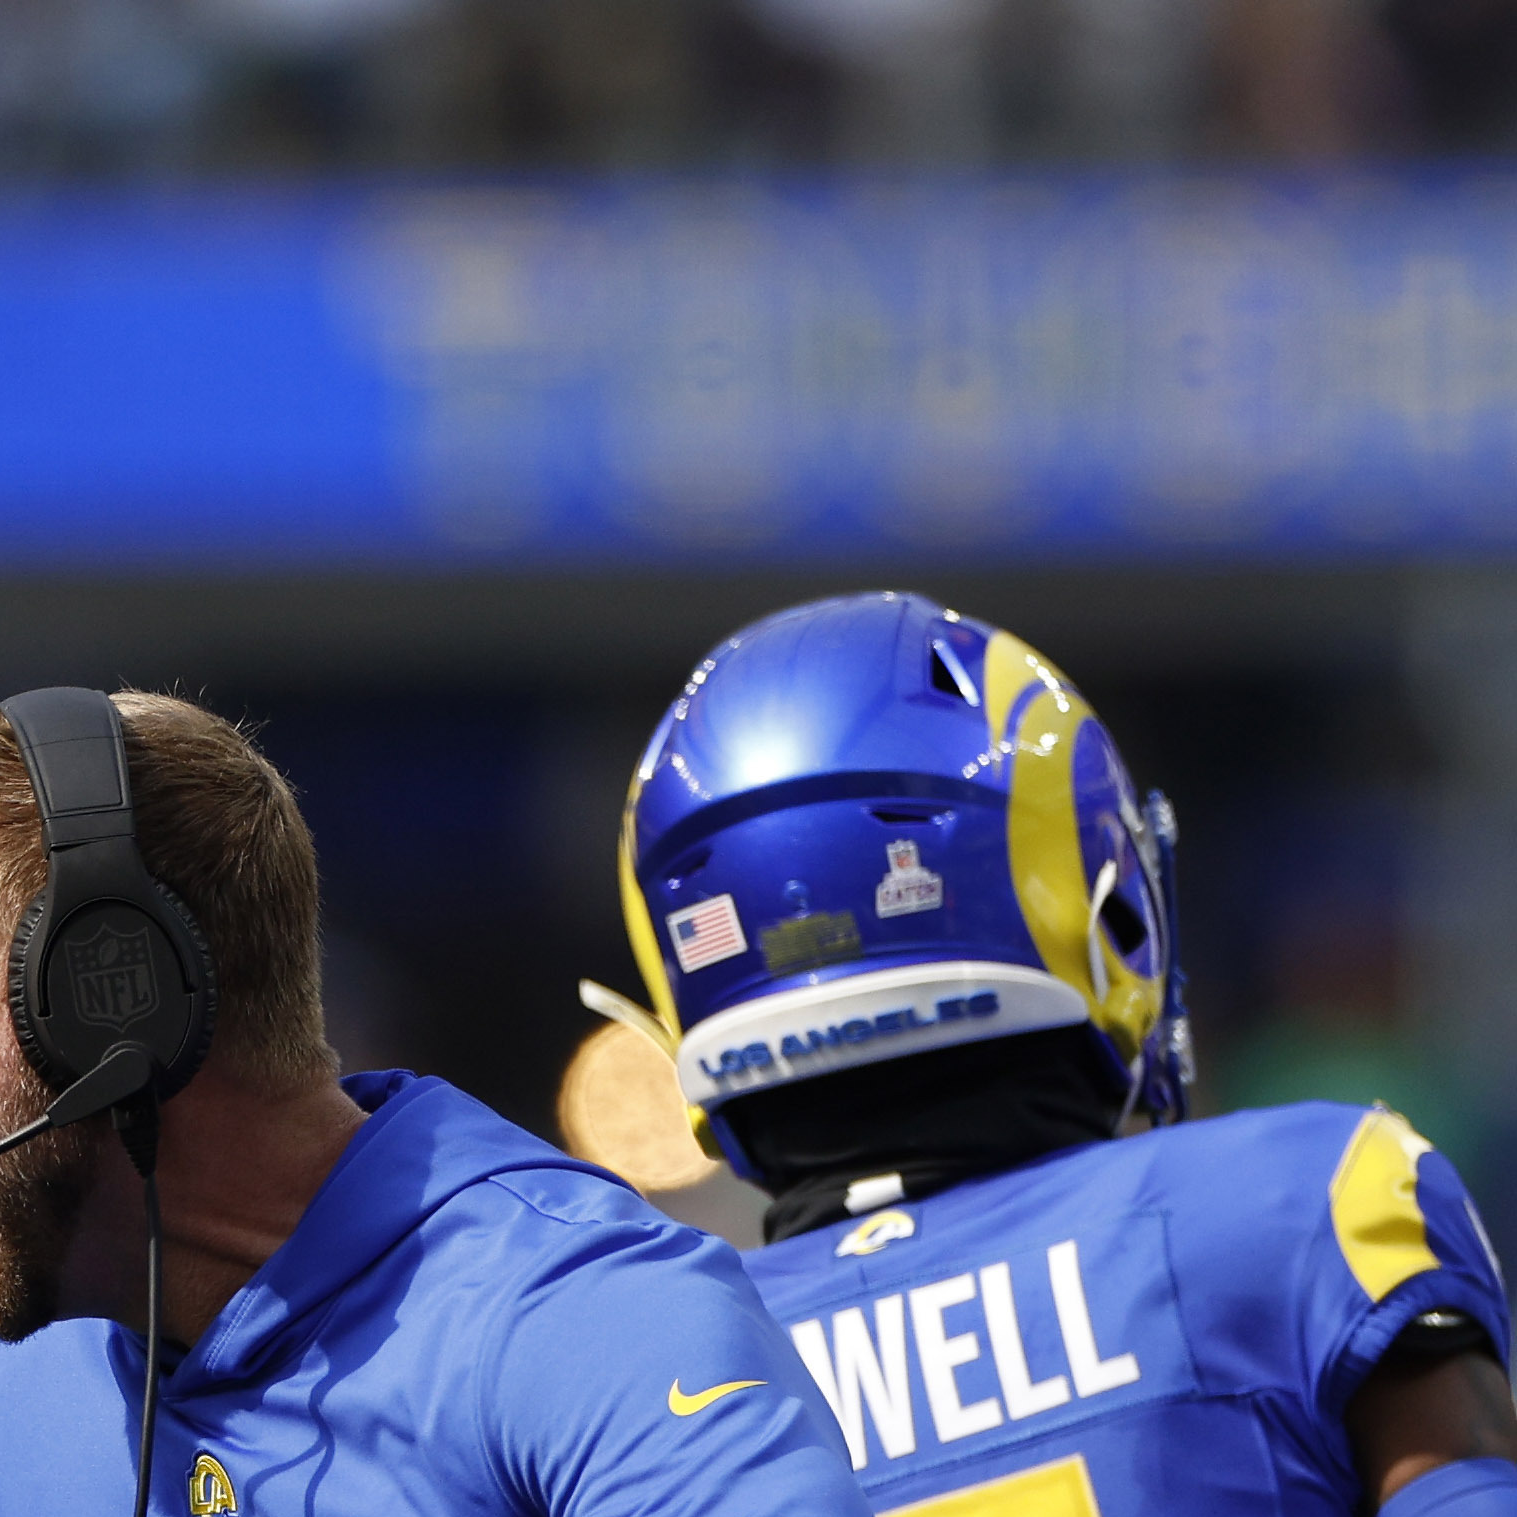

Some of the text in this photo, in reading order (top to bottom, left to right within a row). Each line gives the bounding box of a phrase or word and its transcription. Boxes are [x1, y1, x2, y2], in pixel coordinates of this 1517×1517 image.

[77, 965, 152, 1019] NFL
[700, 991, 1000, 1079] LOS ANGELES
